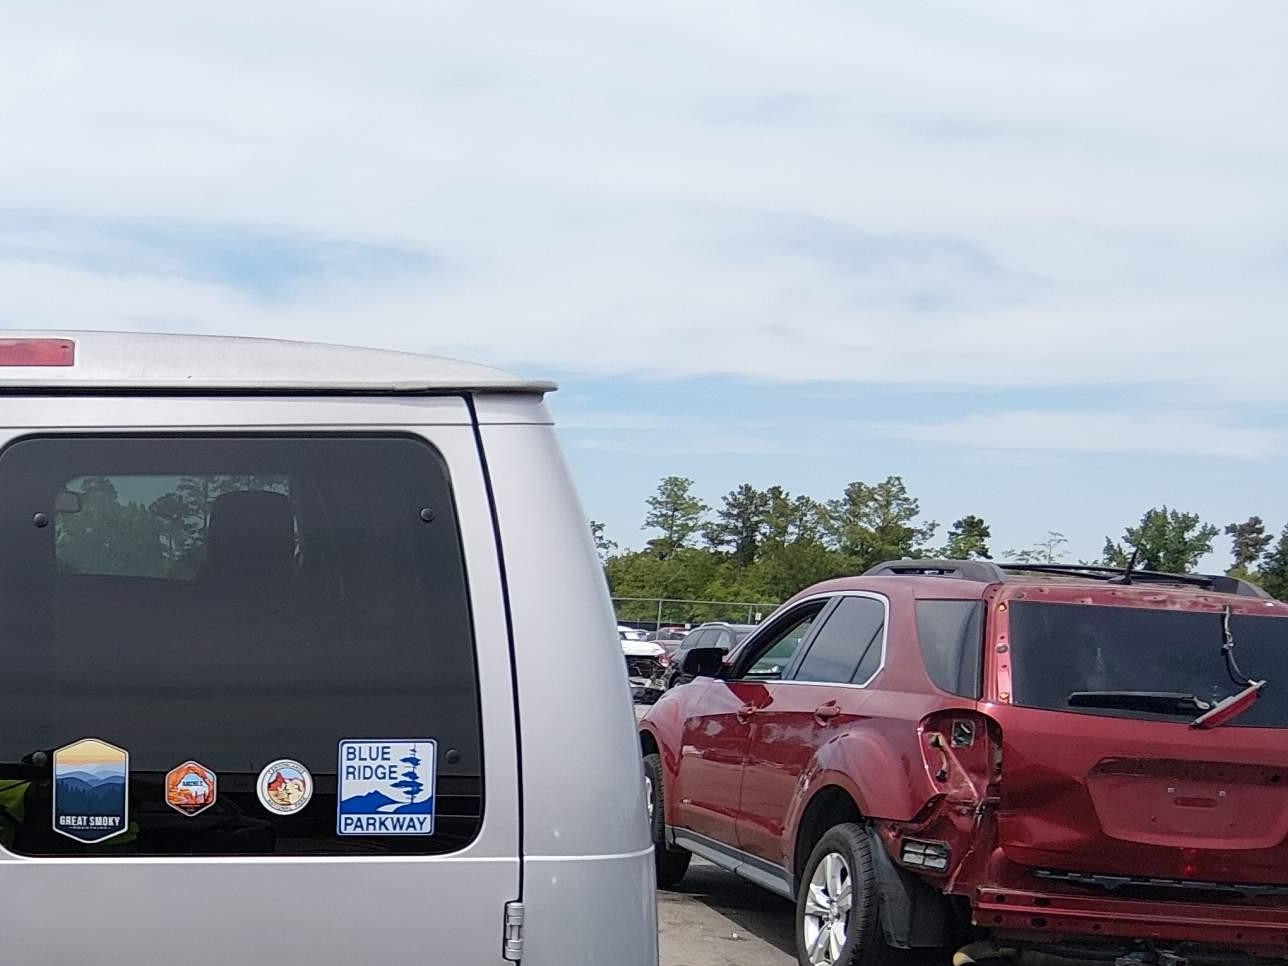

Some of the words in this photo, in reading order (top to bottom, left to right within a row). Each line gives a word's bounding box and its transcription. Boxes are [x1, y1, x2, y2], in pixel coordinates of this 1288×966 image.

[346, 746, 391, 761] BLUE
[345, 765, 398, 780] RIDGE
[59, 815, 88, 826] GREAT
[89, 816, 120, 826] SMOKY
[343, 816, 427, 831] PARKWAY
